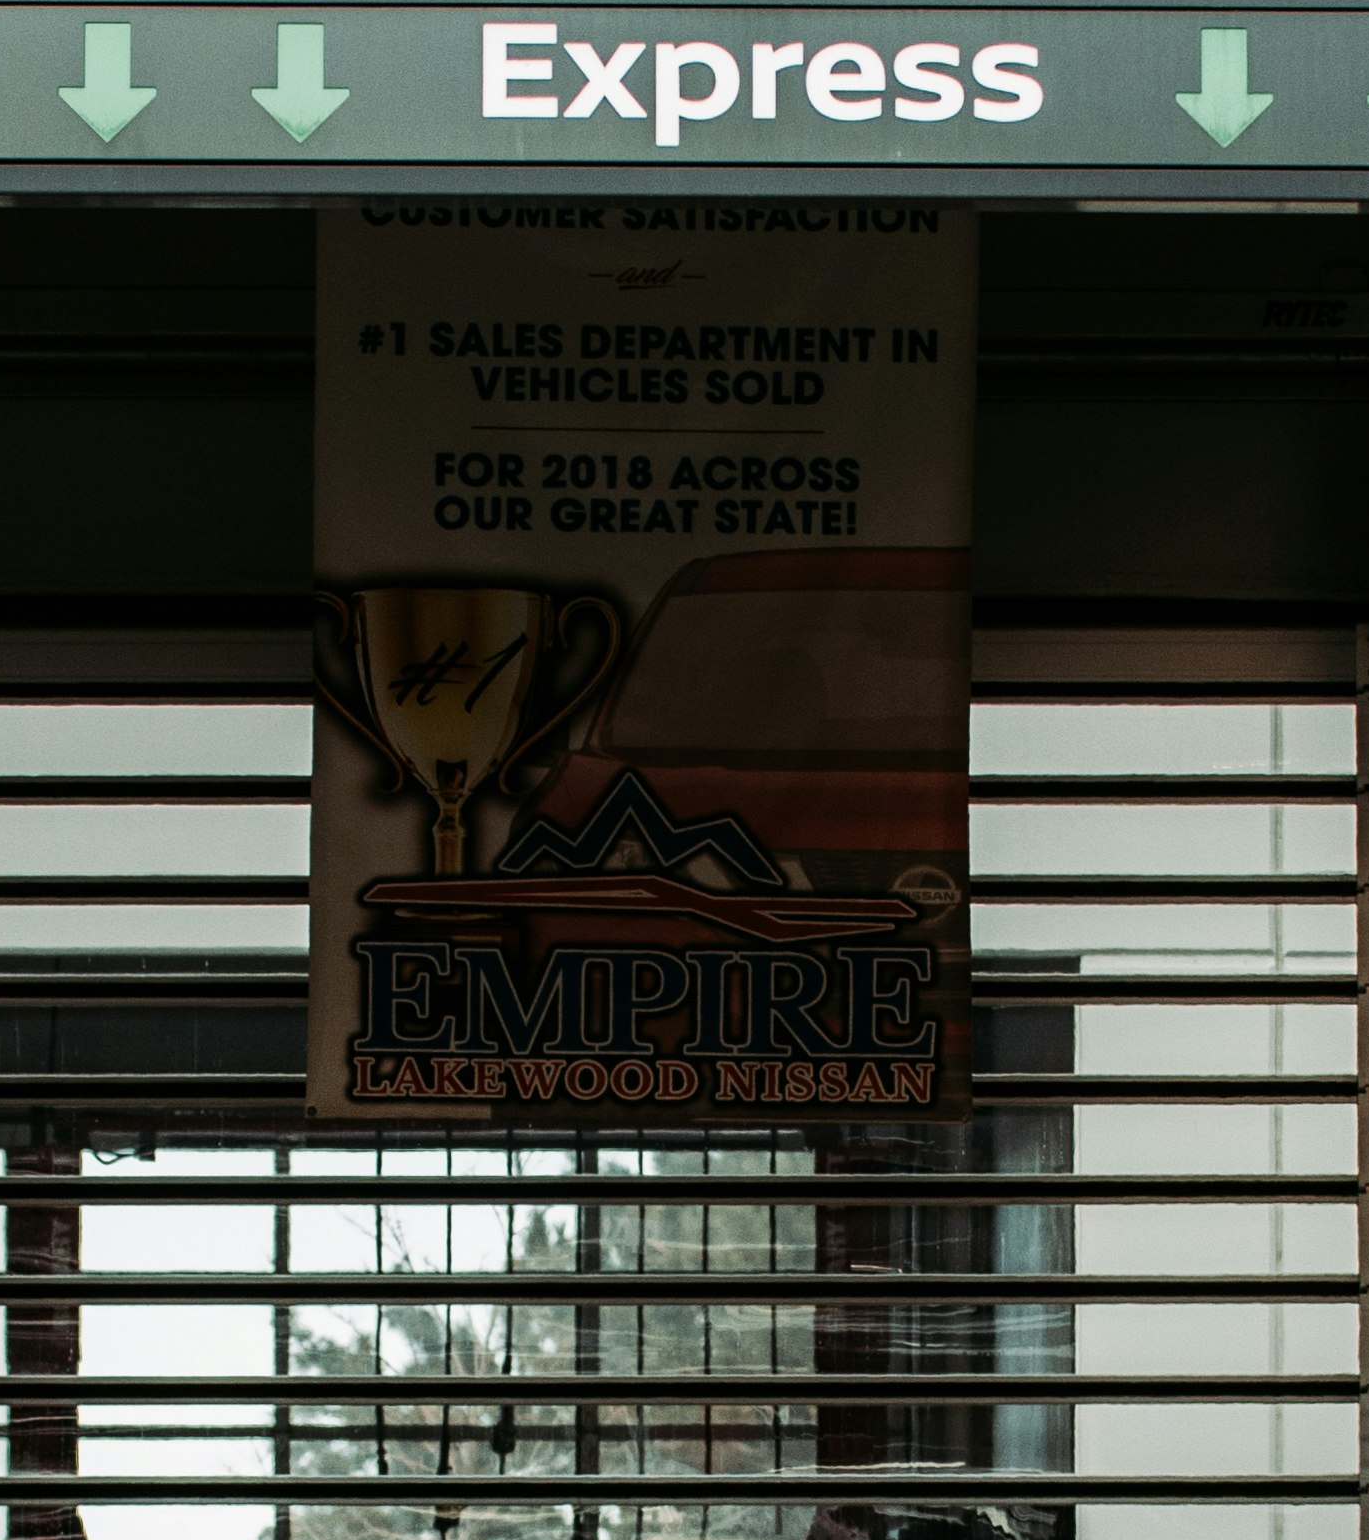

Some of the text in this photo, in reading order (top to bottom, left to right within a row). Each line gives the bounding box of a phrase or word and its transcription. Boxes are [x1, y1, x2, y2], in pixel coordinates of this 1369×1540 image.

[480, 21, 1045, 147] Express
[359, 322, 938, 362] #1 SALES DEPARTMENT IN
[471, 367, 825, 405] VEHICLES SOLD
[434, 452, 860, 493] FOR 2018 ACROSS
[434, 496, 857, 536] OUR GREAT STATE!
[388, 631, 528, 712] #1
[354, 942, 936, 1058] EMPIRE
[352, 1057, 934, 1103] LAKEWOOD NISSAN
